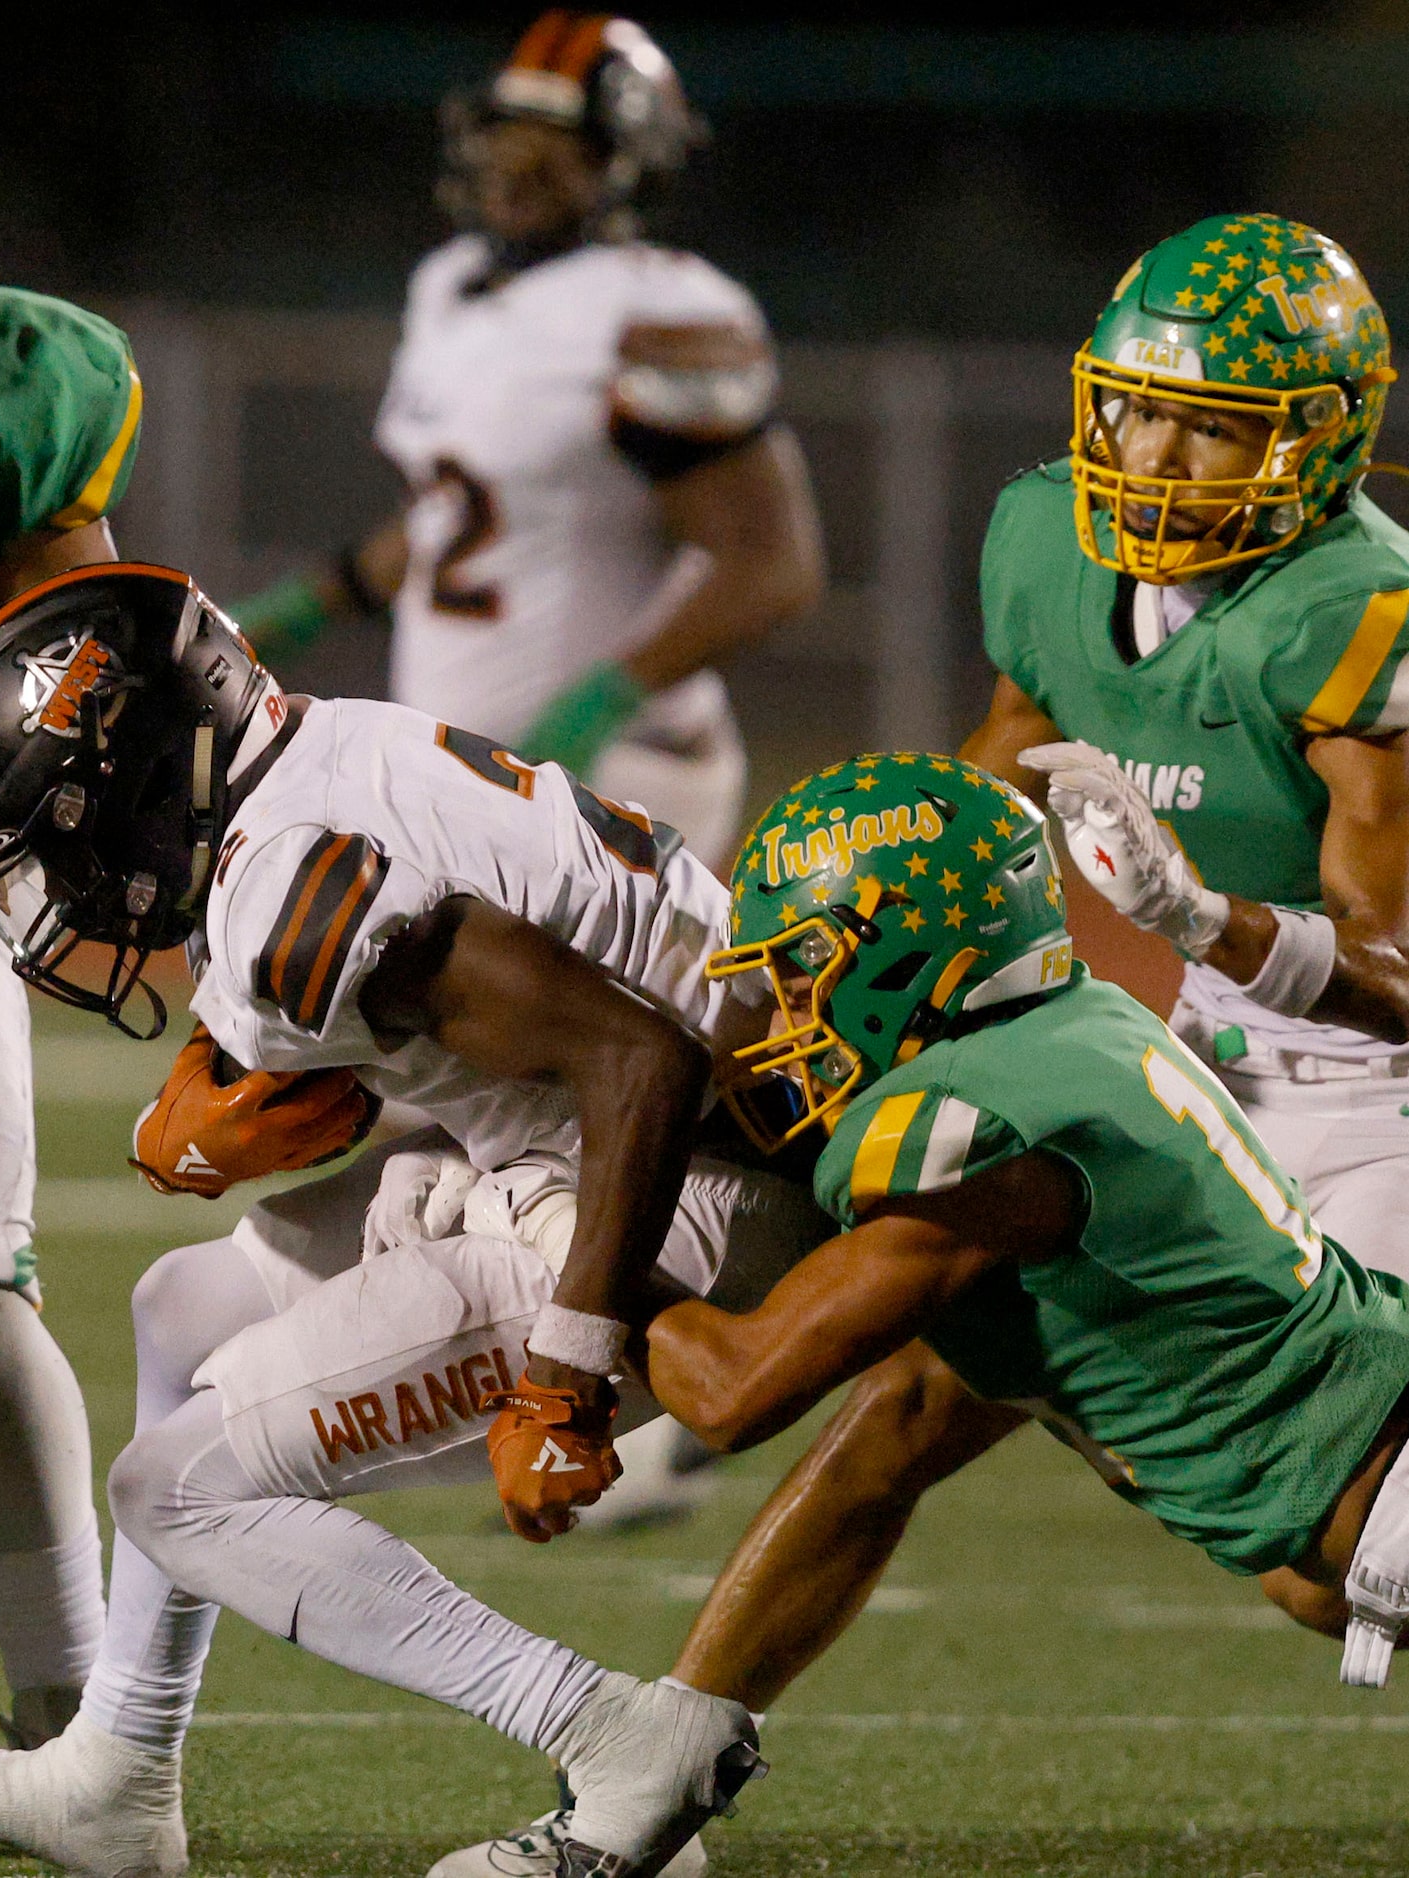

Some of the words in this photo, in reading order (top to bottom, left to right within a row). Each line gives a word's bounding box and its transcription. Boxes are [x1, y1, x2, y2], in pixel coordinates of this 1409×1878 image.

[40, 639, 110, 730] WEST
[763, 800, 943, 886] Trojans
[1040, 943, 1072, 985] FIG
